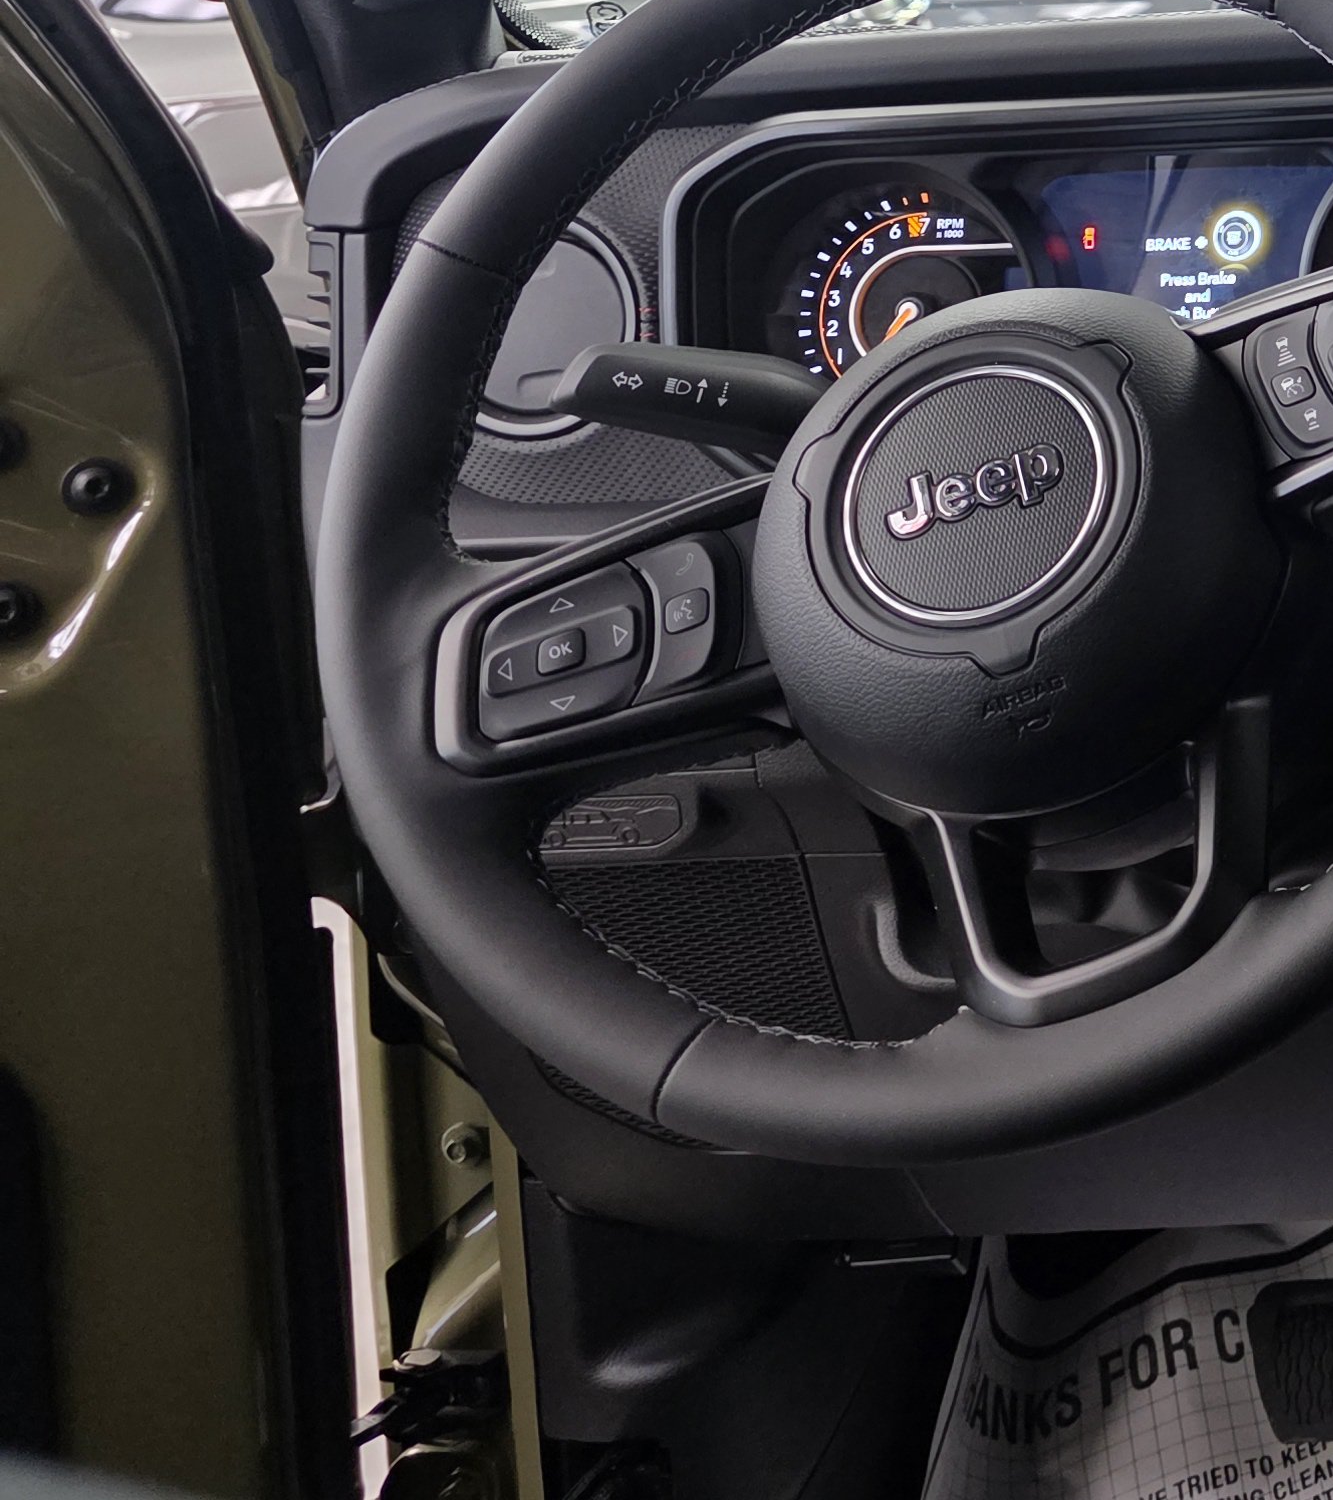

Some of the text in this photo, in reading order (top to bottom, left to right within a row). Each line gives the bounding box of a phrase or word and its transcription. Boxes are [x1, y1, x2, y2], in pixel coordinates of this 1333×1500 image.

[889, 223, 901, 240] 6
[936, 218, 964, 230] RPM
[943, 229, 964, 239] 1000
[861, 238, 875, 255] 5
[1145, 237, 1192, 252] BRAKE
[840, 262, 853, 278] 4
[1160, 270, 1237, 287] Press Brake
[829, 290, 841, 308] 3
[1184, 288, 1211, 304] and
[826, 320, 839, 337] 2
[837, 347, 843, 365] 1
[884, 442, 1065, 540] Jeep
[548, 641, 572, 660] OK
[1098, 1318, 1200, 1407] FOR
[1172, 1463, 1240, 1500] TRIED
[1244, 1454, 1274, 1479] TO
